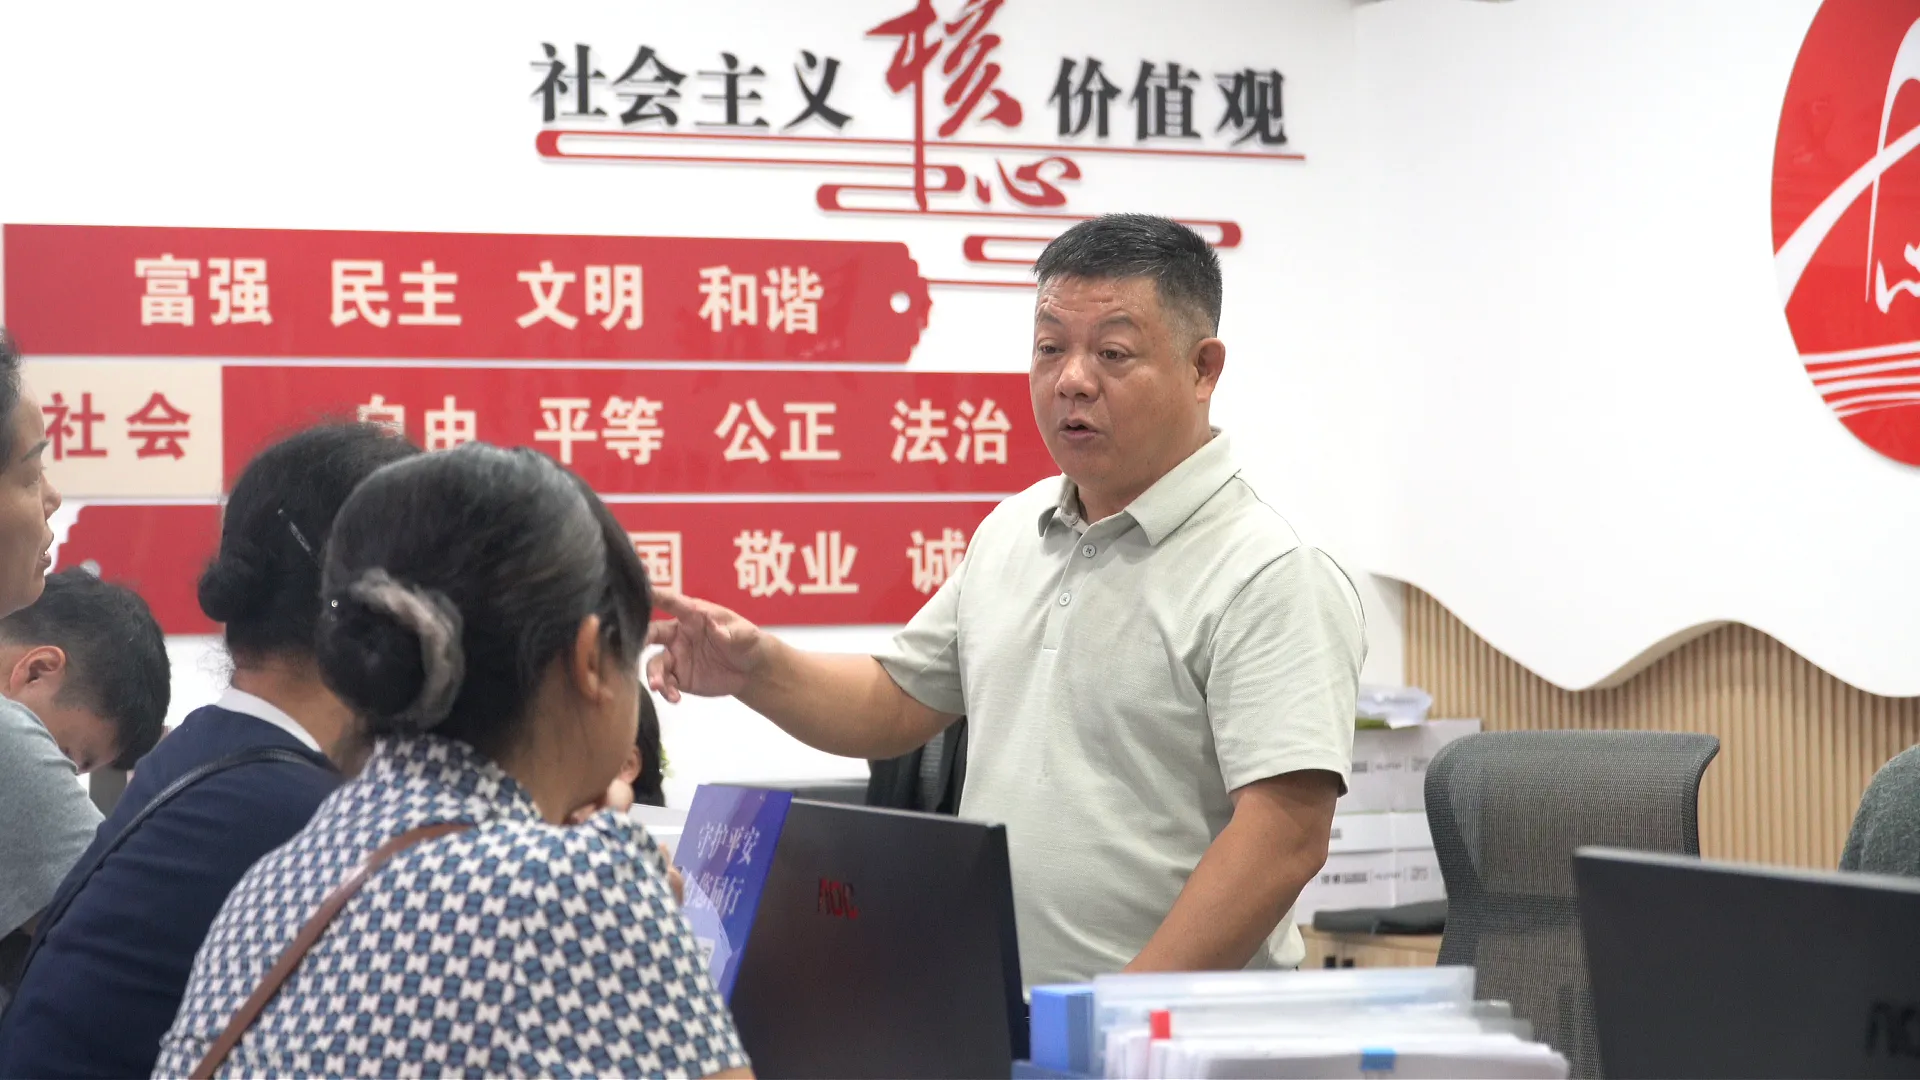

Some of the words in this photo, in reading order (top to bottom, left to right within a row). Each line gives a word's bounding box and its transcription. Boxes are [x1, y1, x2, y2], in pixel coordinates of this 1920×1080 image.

[531, 42, 853, 130] 社会主义
[1049, 56, 1288, 146] 价值观
[134, 253, 273, 327] 富强
[330, 259, 462, 328] 民主
[516, 260, 644, 331] 文明
[698, 265, 824, 334] 和谐
[41, 391, 192, 462] 社会
[533, 395, 665, 465] 平等
[714, 399, 841, 463] 公正
[890, 398, 1012, 465] 法治
[733, 529, 859, 597] 敬业
[697, 823, 760, 865] 守护平安
[817, 877, 859, 920] AOC
